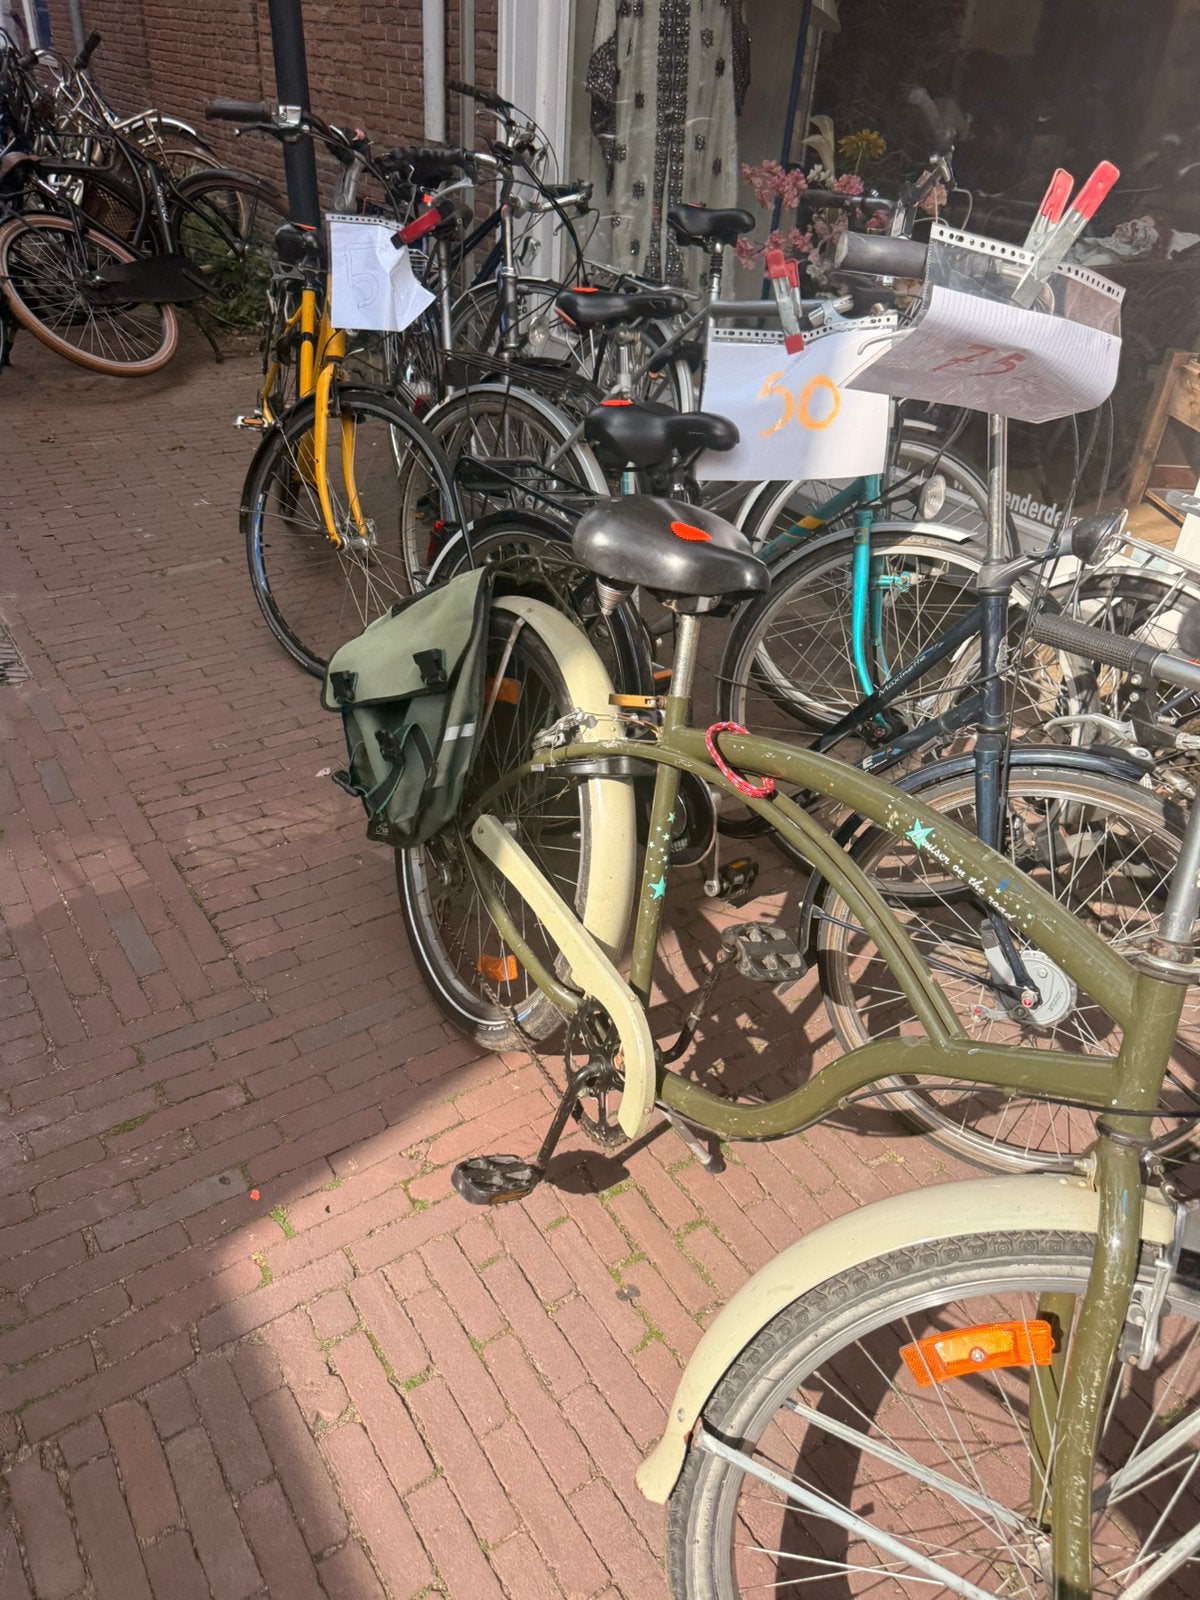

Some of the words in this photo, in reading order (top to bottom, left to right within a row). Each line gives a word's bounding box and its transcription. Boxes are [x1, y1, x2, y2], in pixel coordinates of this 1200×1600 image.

[929, 344, 1025, 377] 75
[755, 371, 841, 439] 50
[952, 864, 966, 878] on
[968, 876, 985, 895] the
[987, 895, 1017, 921] road
